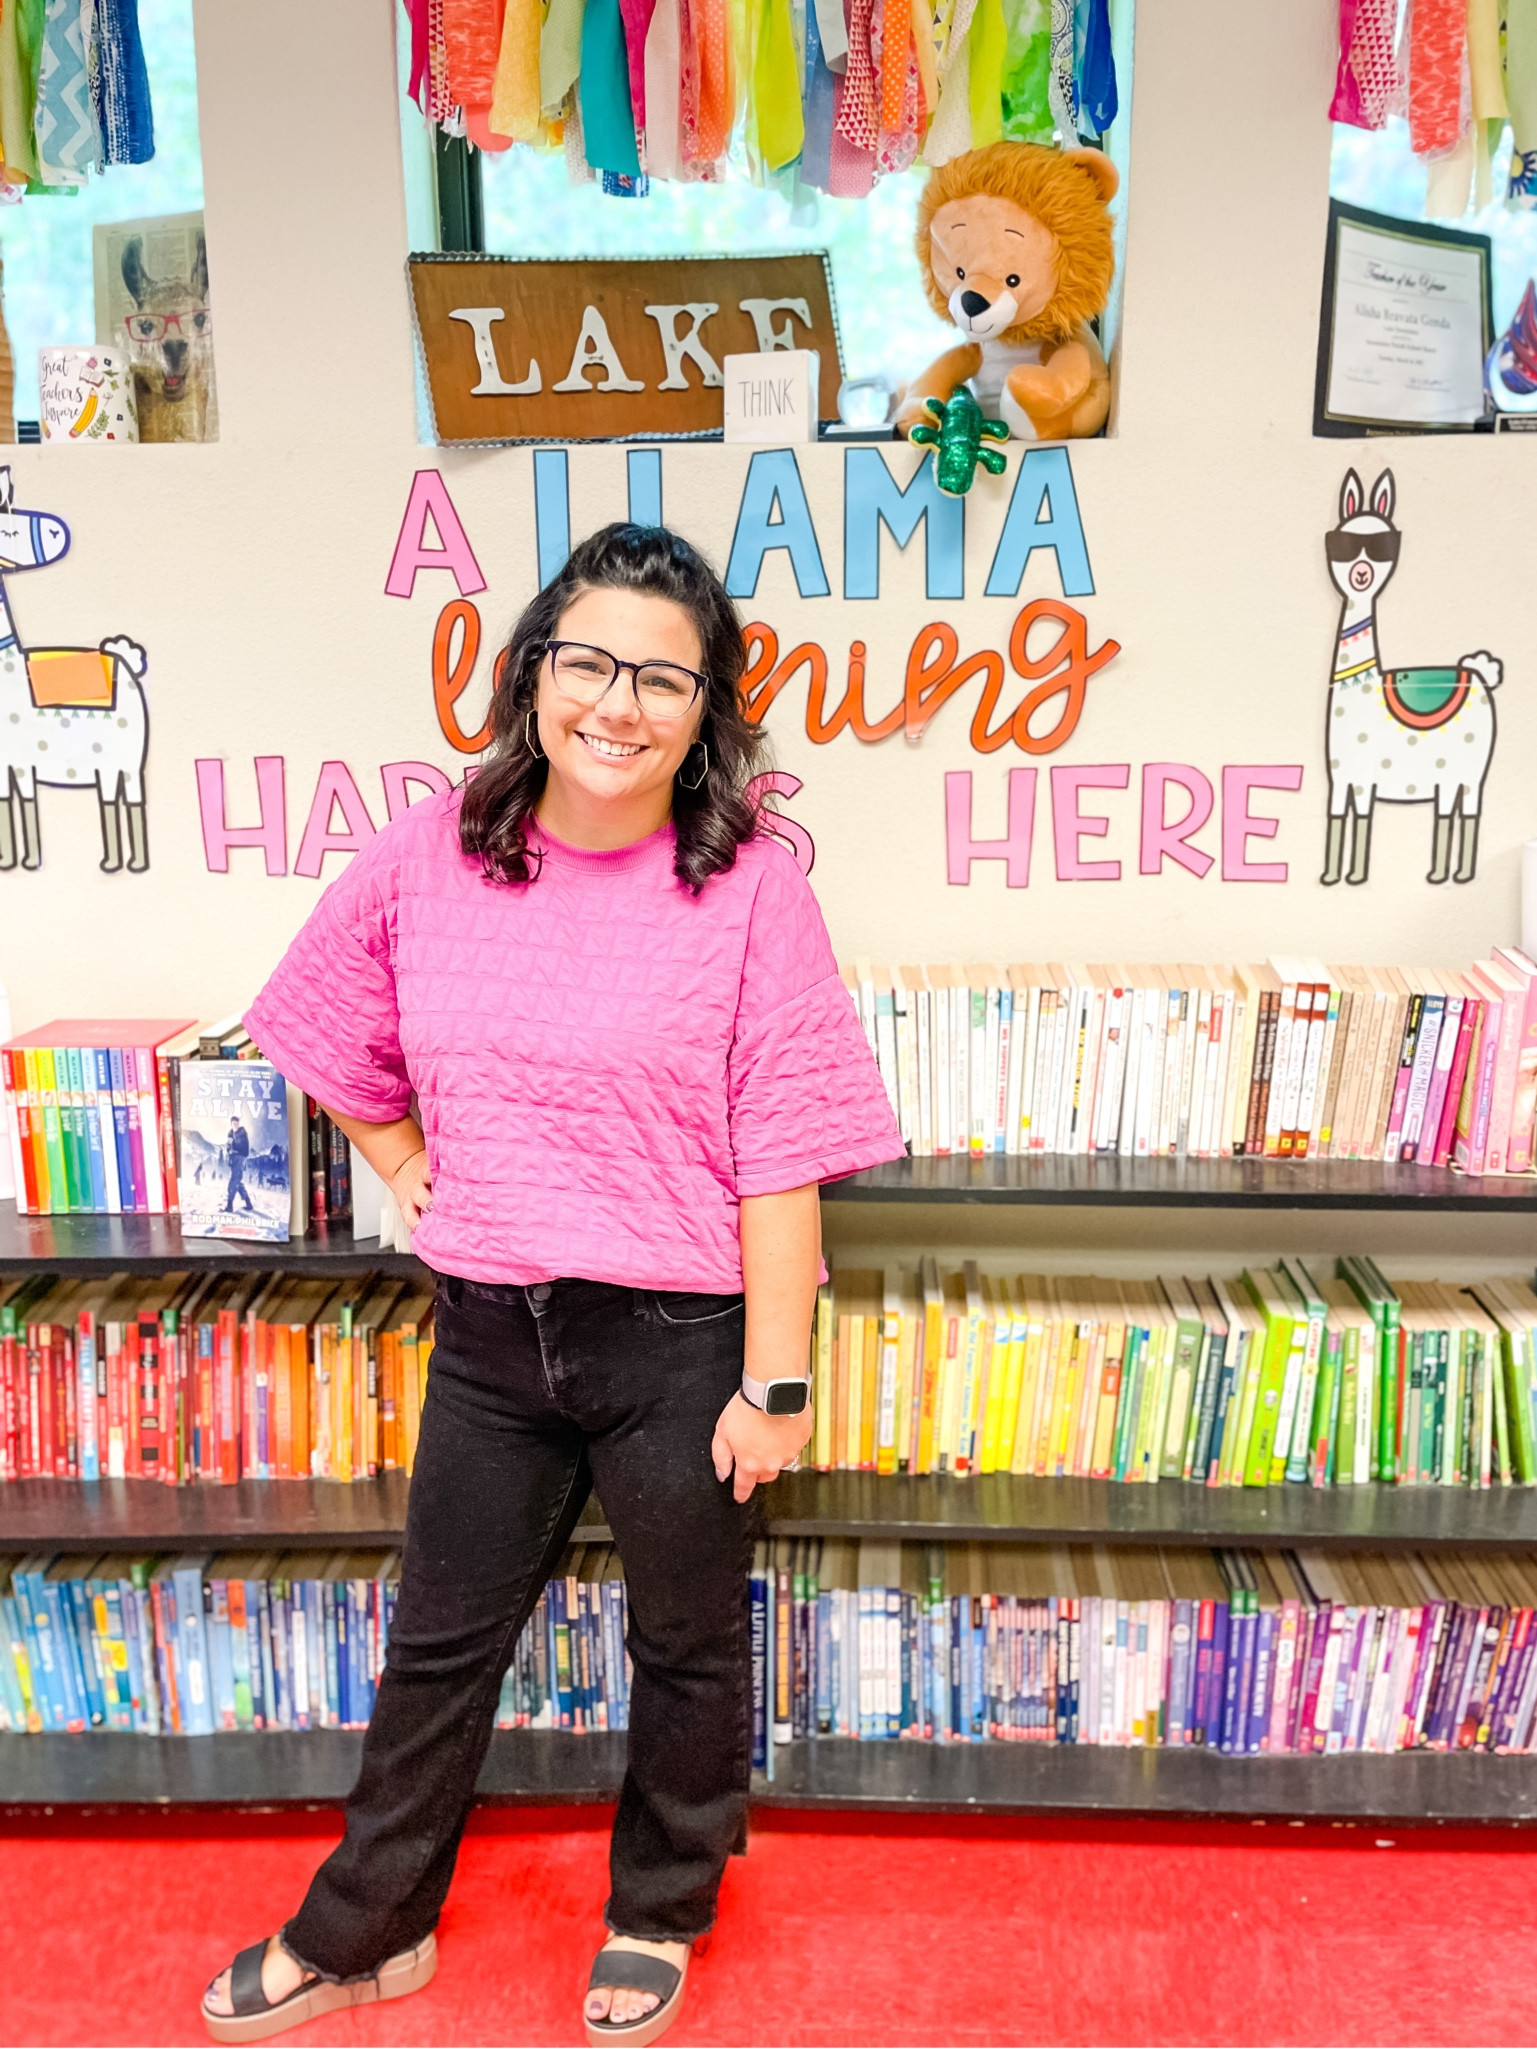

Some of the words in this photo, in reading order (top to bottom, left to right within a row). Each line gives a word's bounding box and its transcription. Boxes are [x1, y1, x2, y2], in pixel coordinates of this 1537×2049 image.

[42, 356, 69, 382] Great
[738, 377, 796, 419] THINK
[44, 402, 81, 426] Inspire
[384, 468, 489, 599] A
[944, 763, 1304, 888] HERE
[1418, 1028, 1437, 1066] SNICKER
[198, 1078, 274, 1099] STAY
[1411, 1078, 1427, 1109] MAGIC
[190, 1099, 282, 1120] ALIVE
[192, 1215, 233, 1226] RODMAN
[234, 1217, 280, 1229] PHILBRICK
[751, 1612, 765, 1653] LITTLE
